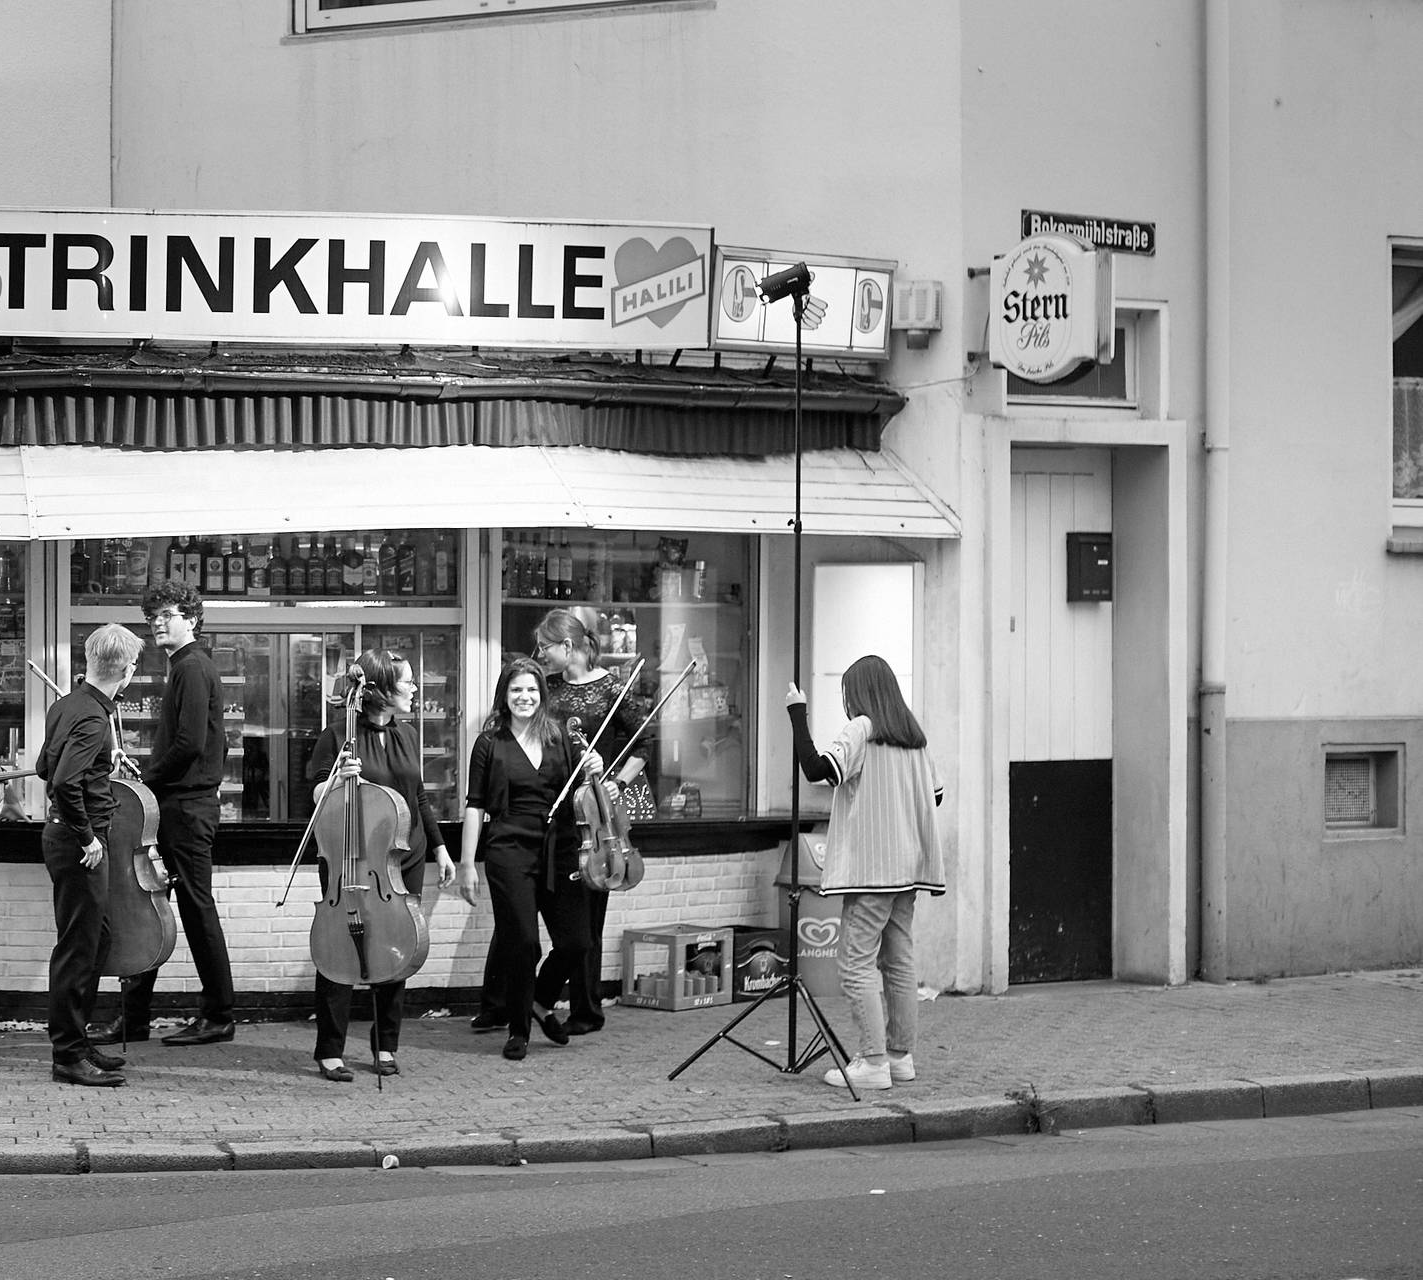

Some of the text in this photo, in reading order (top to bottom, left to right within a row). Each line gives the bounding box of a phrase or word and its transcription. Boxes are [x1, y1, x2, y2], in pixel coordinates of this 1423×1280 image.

[622, 272, 693, 313] HALILI
[1003, 290, 1068, 323] Stern
[1017, 321, 1050, 351] Pils
